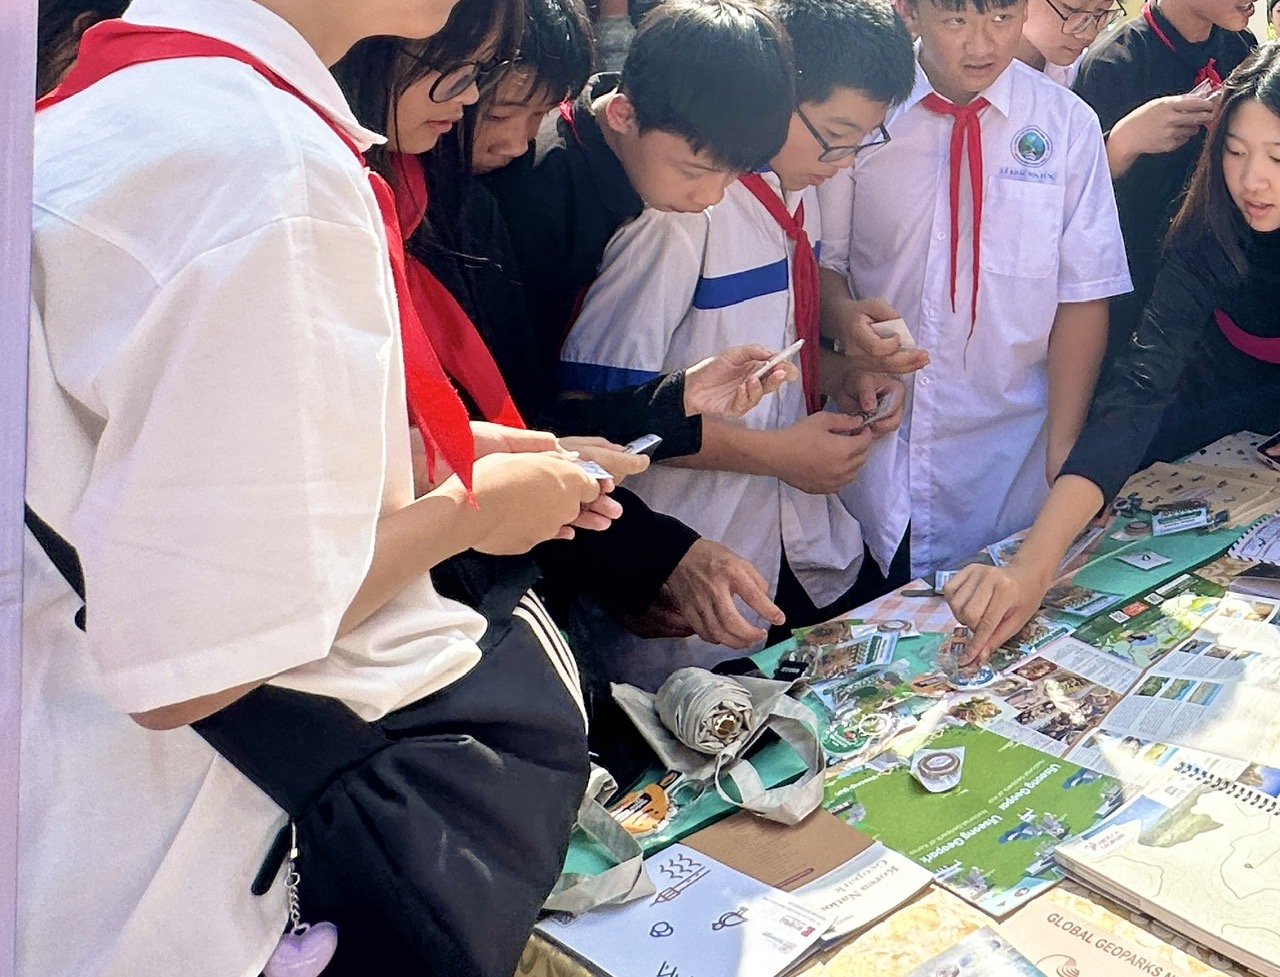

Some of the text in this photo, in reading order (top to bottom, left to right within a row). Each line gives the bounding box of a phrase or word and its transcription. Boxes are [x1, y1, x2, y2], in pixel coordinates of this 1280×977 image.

[919, 814, 1004, 864] Uiseong Geopark
[834, 859, 888, 893] Geopark
[860, 864, 899, 891] Korea
[1046, 912, 1164, 977] GLOBAL GEOPARKS
